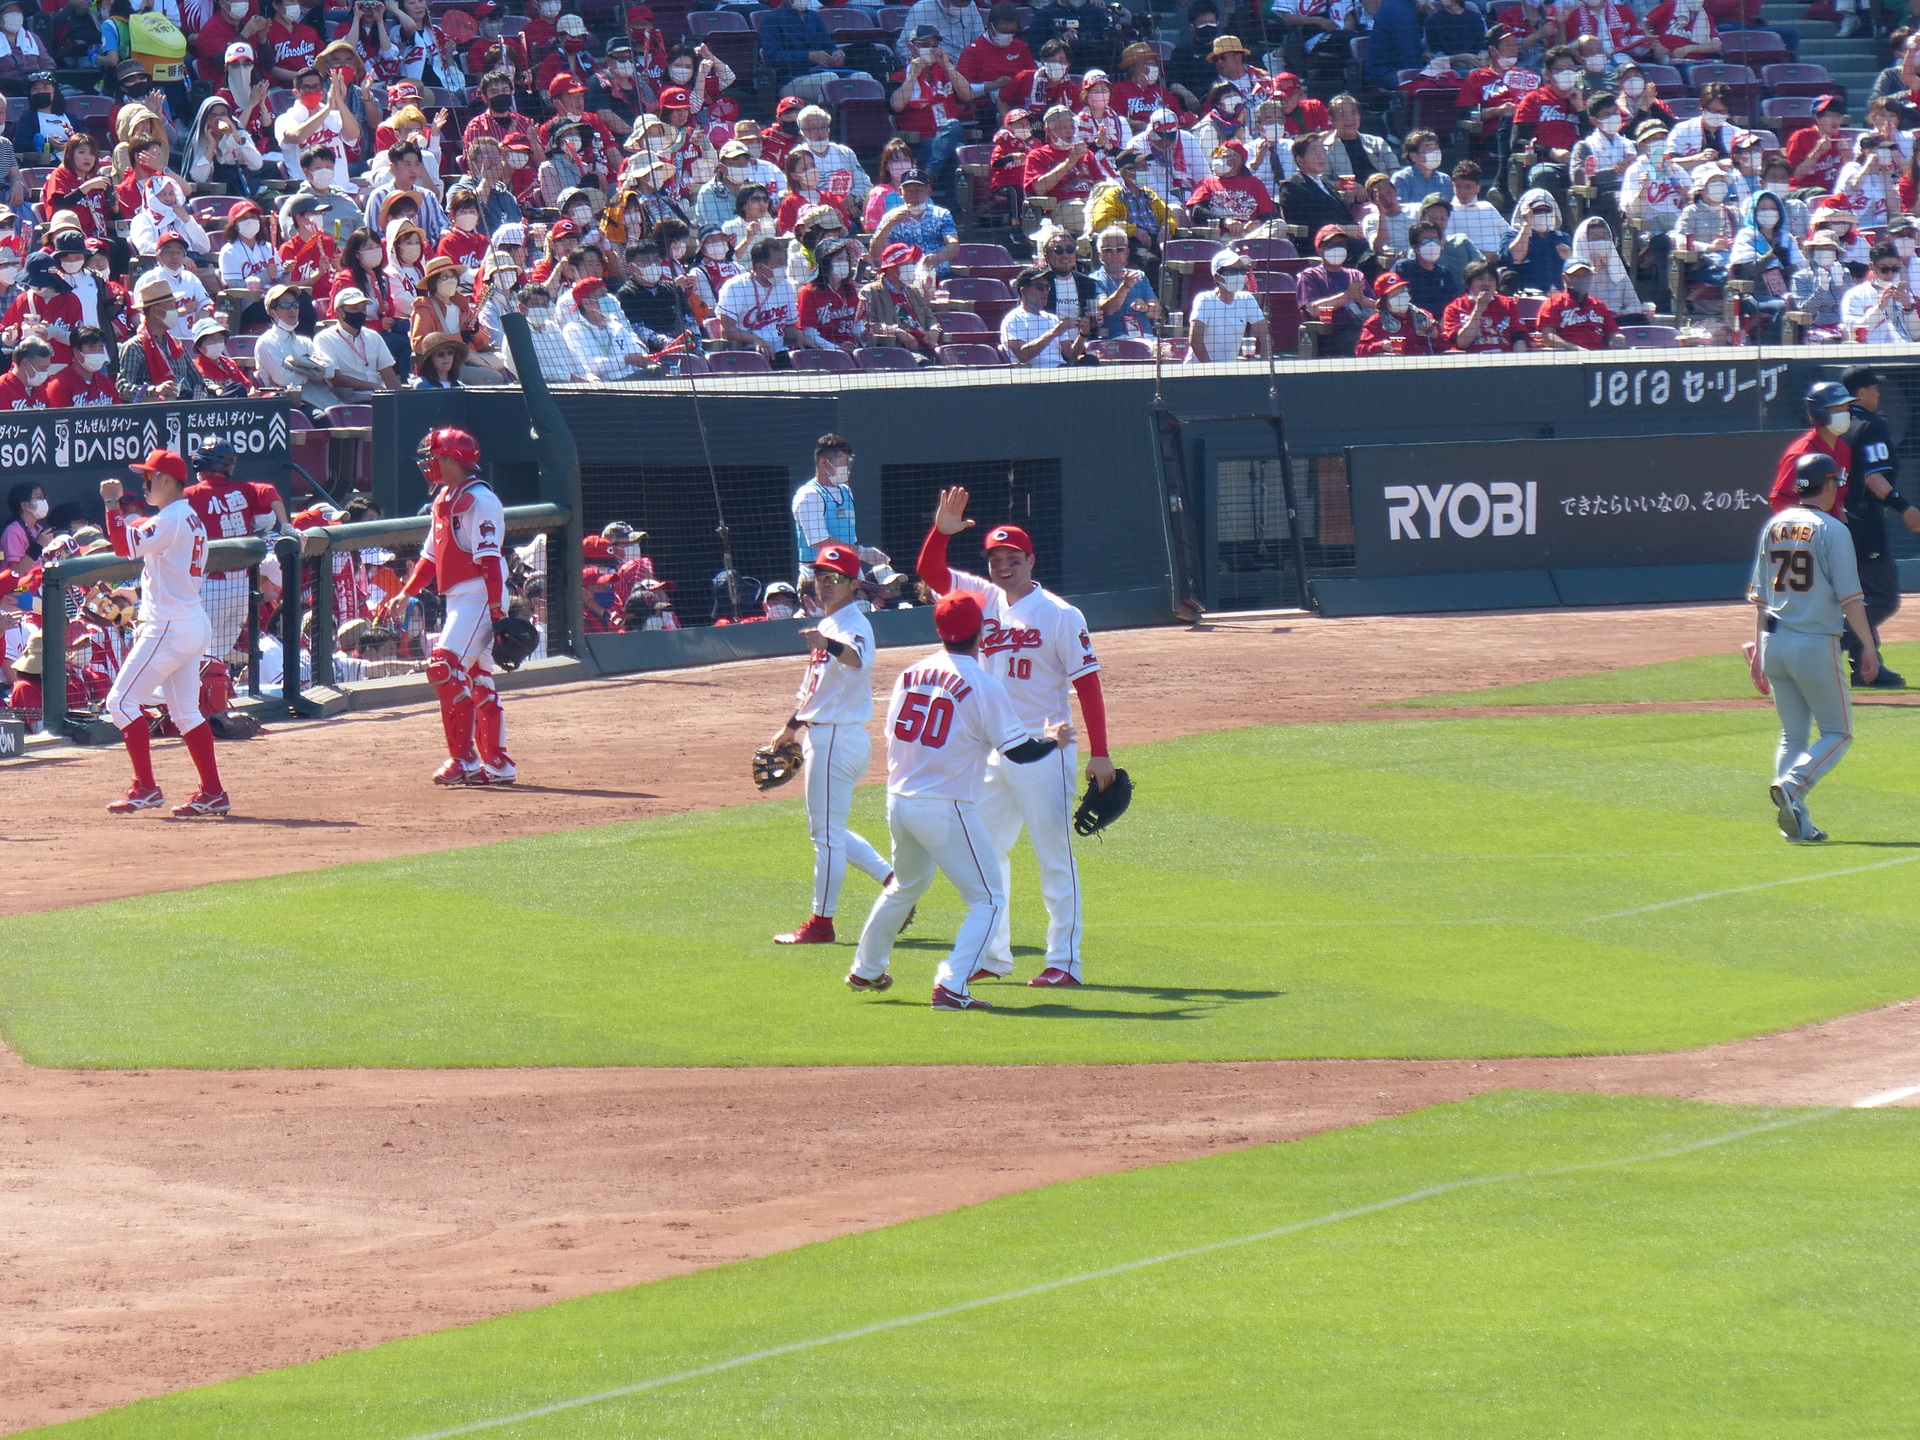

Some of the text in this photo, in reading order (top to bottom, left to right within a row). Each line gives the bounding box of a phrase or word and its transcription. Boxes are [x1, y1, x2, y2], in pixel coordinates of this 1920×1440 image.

[75, 436, 140, 463] DAISO
[1865, 442, 1889, 463] 10
[1384, 481, 1537, 540] RYOBI
[1770, 527, 1816, 545] KAMEI
[1770, 549, 1816, 593] 79
[1008, 656, 1032, 680] 10
[894, 691, 954, 749] 50
